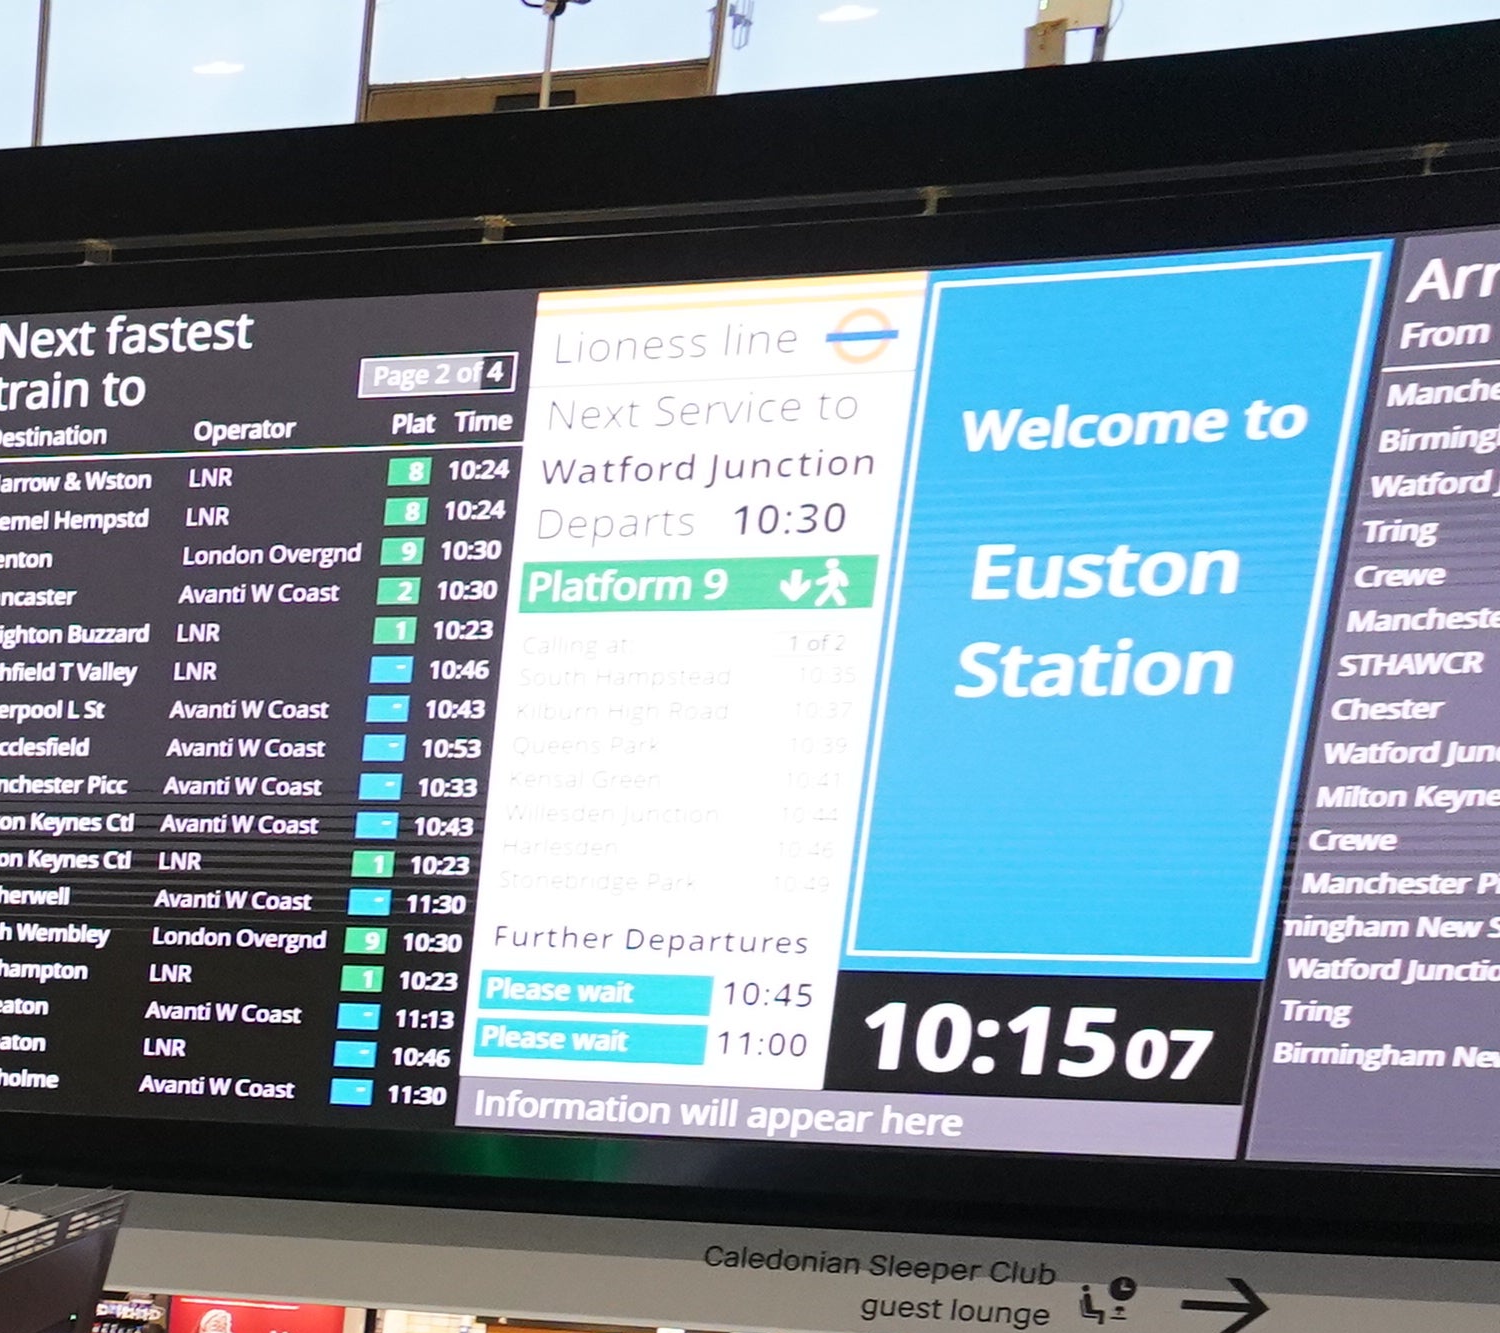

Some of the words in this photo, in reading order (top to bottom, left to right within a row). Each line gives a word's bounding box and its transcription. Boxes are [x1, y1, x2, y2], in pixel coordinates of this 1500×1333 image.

[107, 314, 254, 355] fastest
[555, 330, 707, 365] Lioness
[724, 322, 799, 356] line
[1400, 321, 1490, 349] From
[103, 373, 147, 408] to
[194, 419, 297, 444] Operator
[455, 410, 513, 434] Time
[548, 398, 640, 431] Next
[655, 394, 802, 428] Service
[818, 392, 858, 421] to
[962, 402, 1229, 452] Welcome
[1244, 400, 1309, 441] to
[543, 453, 696, 486] Watford
[705, 450, 875, 489] Junction
[537, 507, 695, 548] Departs
[734, 501, 847, 535] 10:30
[1363, 519, 1438, 548] Tring
[527, 569, 692, 604] Platform
[705, 568, 729, 601] 9
[971, 543, 1240, 601] Euston
[1355, 564, 1446, 588] Crewe
[954, 638, 1235, 699] Station
[1338, 651, 1485, 677] STHAWCR
[1331, 698, 1445, 722] Chester
[495, 924, 616, 954] Further
[626, 926, 810, 959] Departures
[486, 976, 579, 1008] Please
[585, 979, 634, 1006] wait
[724, 981, 813, 1008] 10:45
[865, 999, 1117, 1080] 10:15
[1124, 1028, 1215, 1081] 07
[474, 1087, 671, 1127] Information
[680, 1098, 738, 1129] will
[747, 1104, 874, 1141] appear
[882, 1104, 963, 1137] here
[704, 1245, 860, 1275] Caledonian
[869, 1255, 980, 1284] Sleeper
[990, 1261, 1056, 1285] Club
[861, 1298, 942, 1321] guest
[950, 1300, 1050, 1329] lounge
